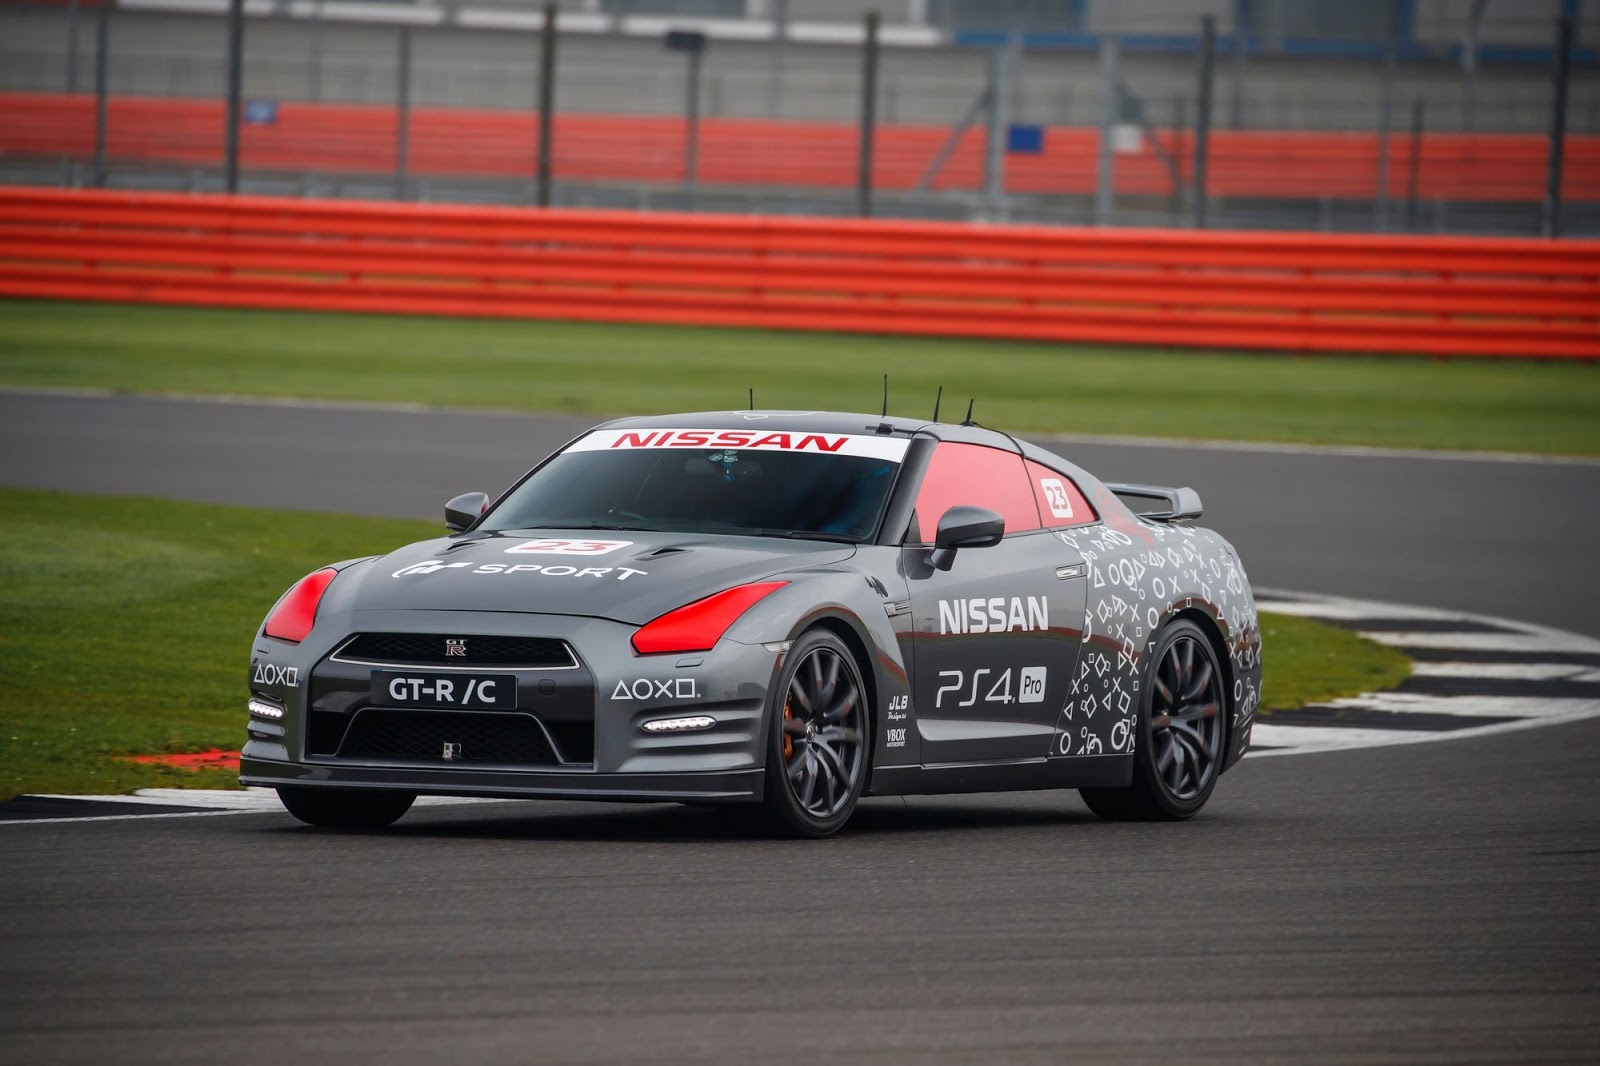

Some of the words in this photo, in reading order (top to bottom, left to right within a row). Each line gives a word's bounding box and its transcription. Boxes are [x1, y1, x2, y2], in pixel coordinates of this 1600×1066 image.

[611, 431, 850, 452] NISSAN
[1046, 486, 1068, 509] 23
[519, 541, 611, 552] 23
[472, 563, 648, 581] SPORT
[938, 596, 1049, 635] NISSAN
[445, 645, 466, 656] R
[389, 677, 455, 702] GT-R
[461, 679, 496, 705] /C
[1023, 675, 1042, 695] Pro
[889, 695, 908, 710] JLB
[887, 728, 906, 741] VBOX
